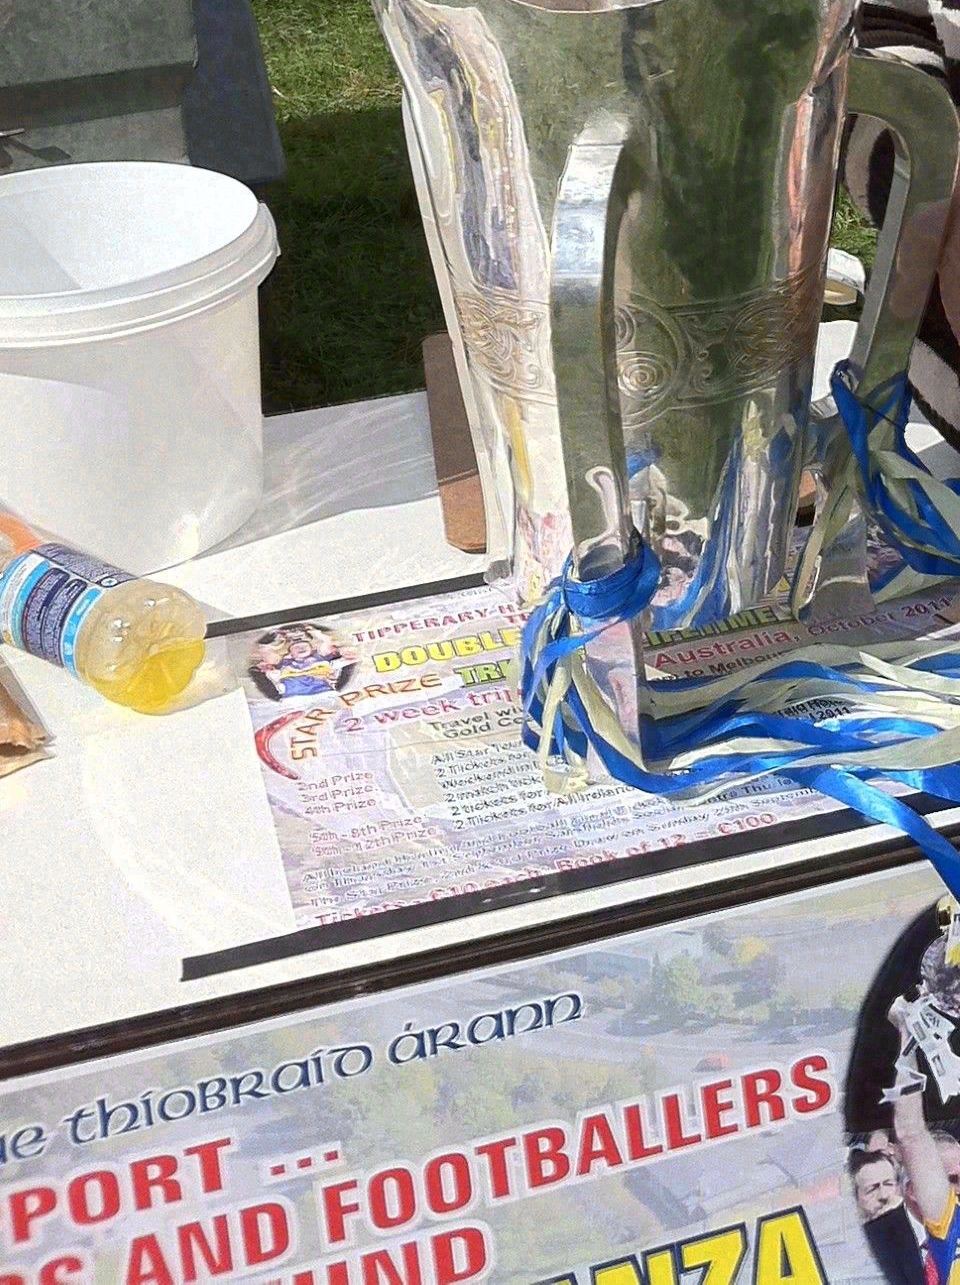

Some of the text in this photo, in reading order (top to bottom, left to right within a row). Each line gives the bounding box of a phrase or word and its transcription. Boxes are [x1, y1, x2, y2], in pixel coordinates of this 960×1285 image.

[344, 716, 365, 733] 2
[374, 699, 461, 724] week
[901, 596, 952, 619] 2011
[290, 673, 443, 761] STAR PRIZE
[427, 711, 490, 732] Travel
[442, 721, 492, 739] Gold
[126, 1053, 832, 1285] AND FOOTBALLERS
